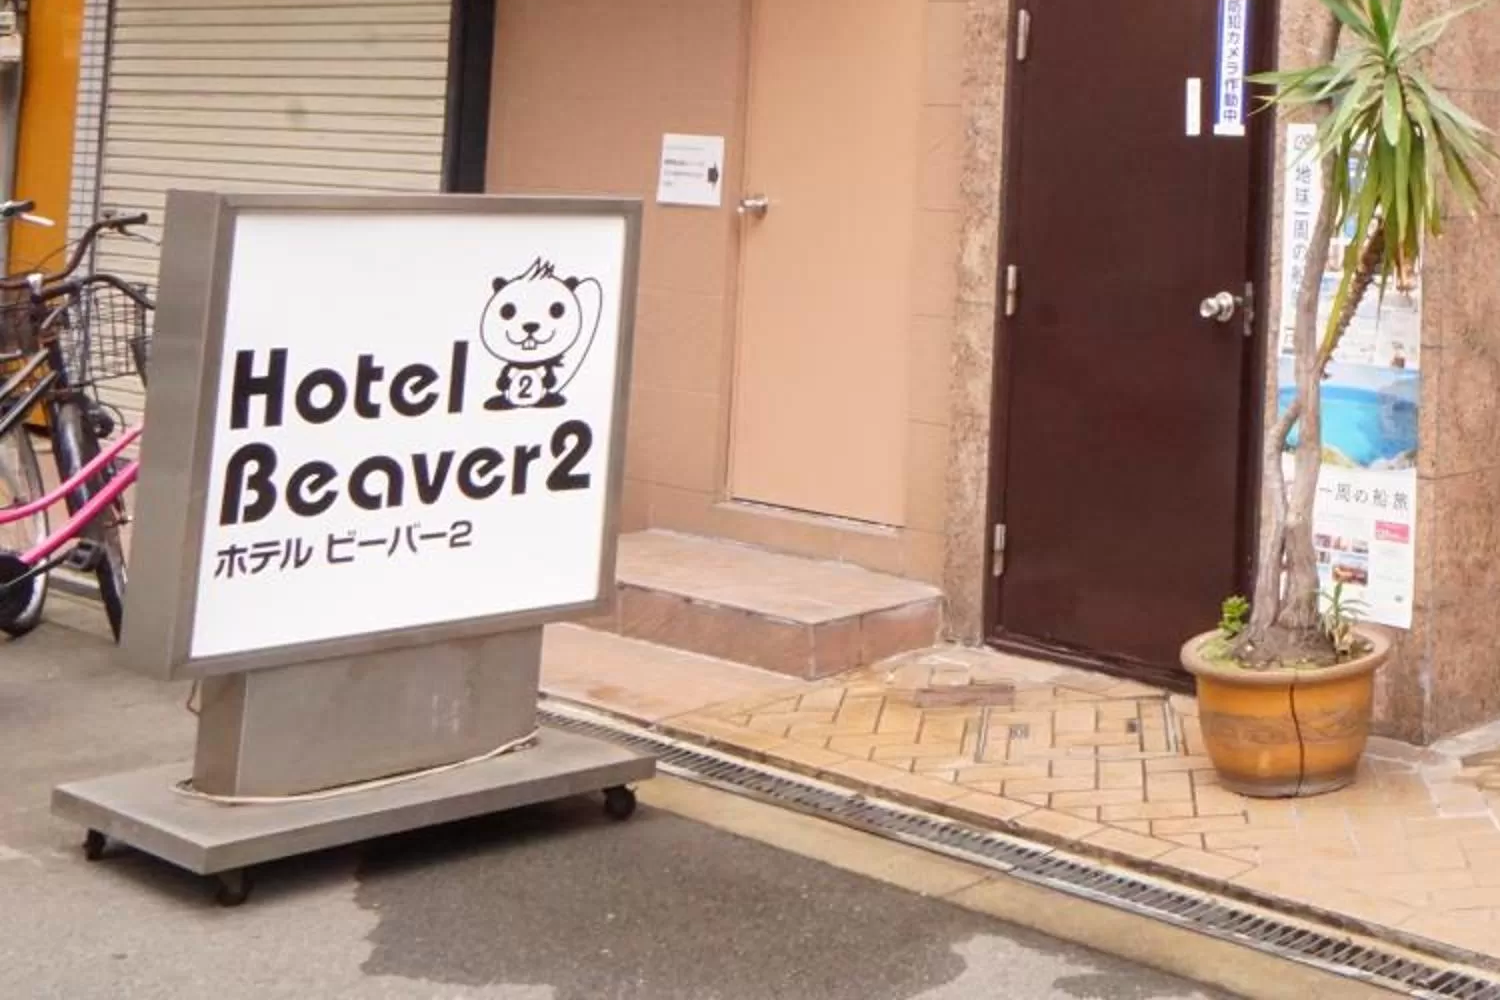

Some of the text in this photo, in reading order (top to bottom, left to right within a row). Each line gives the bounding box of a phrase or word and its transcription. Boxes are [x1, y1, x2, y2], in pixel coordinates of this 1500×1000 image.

[1223, 0, 1242, 122] 防犯カメラ作動中
[230, 341, 469, 430] Hotel
[517, 376, 533, 399] 2
[213, 519, 473, 579] ホテル ビーバー2
